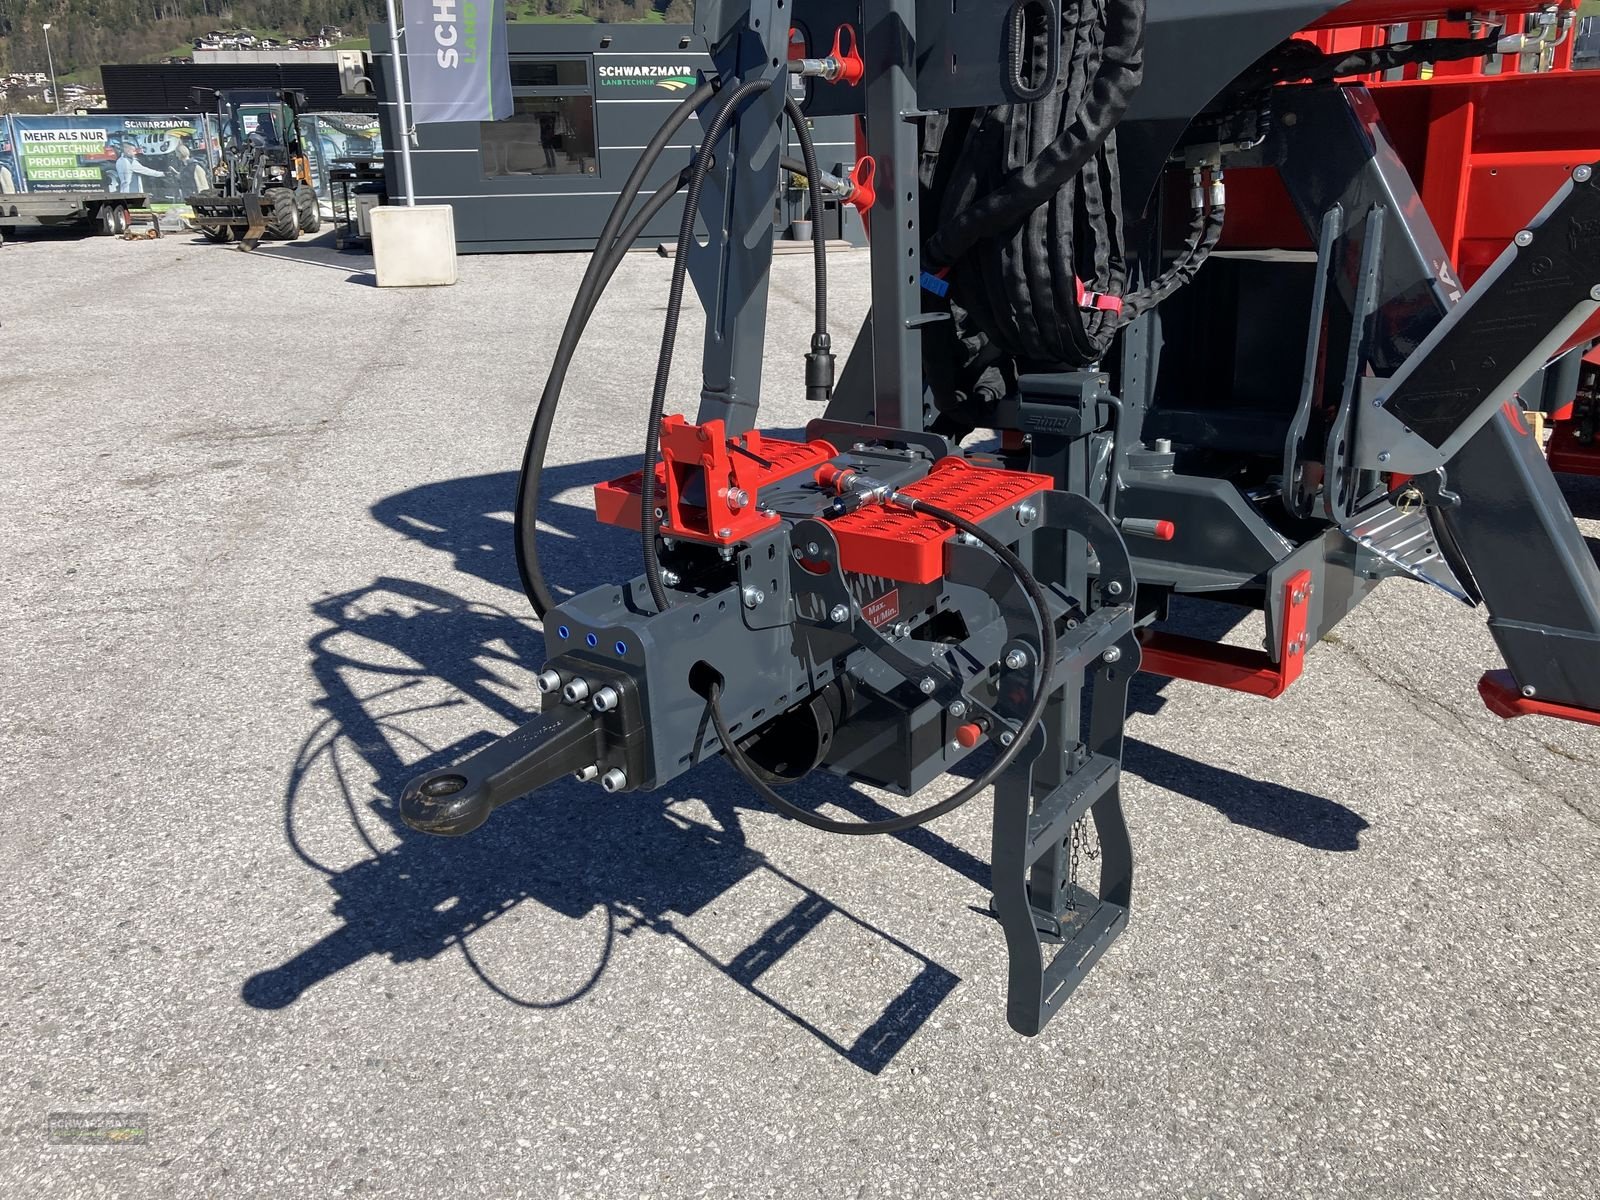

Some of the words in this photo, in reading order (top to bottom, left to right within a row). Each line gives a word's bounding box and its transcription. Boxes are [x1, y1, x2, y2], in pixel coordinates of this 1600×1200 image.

[598, 66, 691, 77] SCHWARZMAYR
[124, 120, 190, 129] SCHWARZMAYR
[24, 132, 56, 141] MEHR
[58, 132, 78, 141] ALS
[80, 131, 105, 141] NUR
[26, 145, 101, 154] LANDTECHNIK
[29, 157, 74, 167] PROMPT
[30, 168, 98, 179] VERFÜGBAR!
[868, 602, 886, 616] Max.
